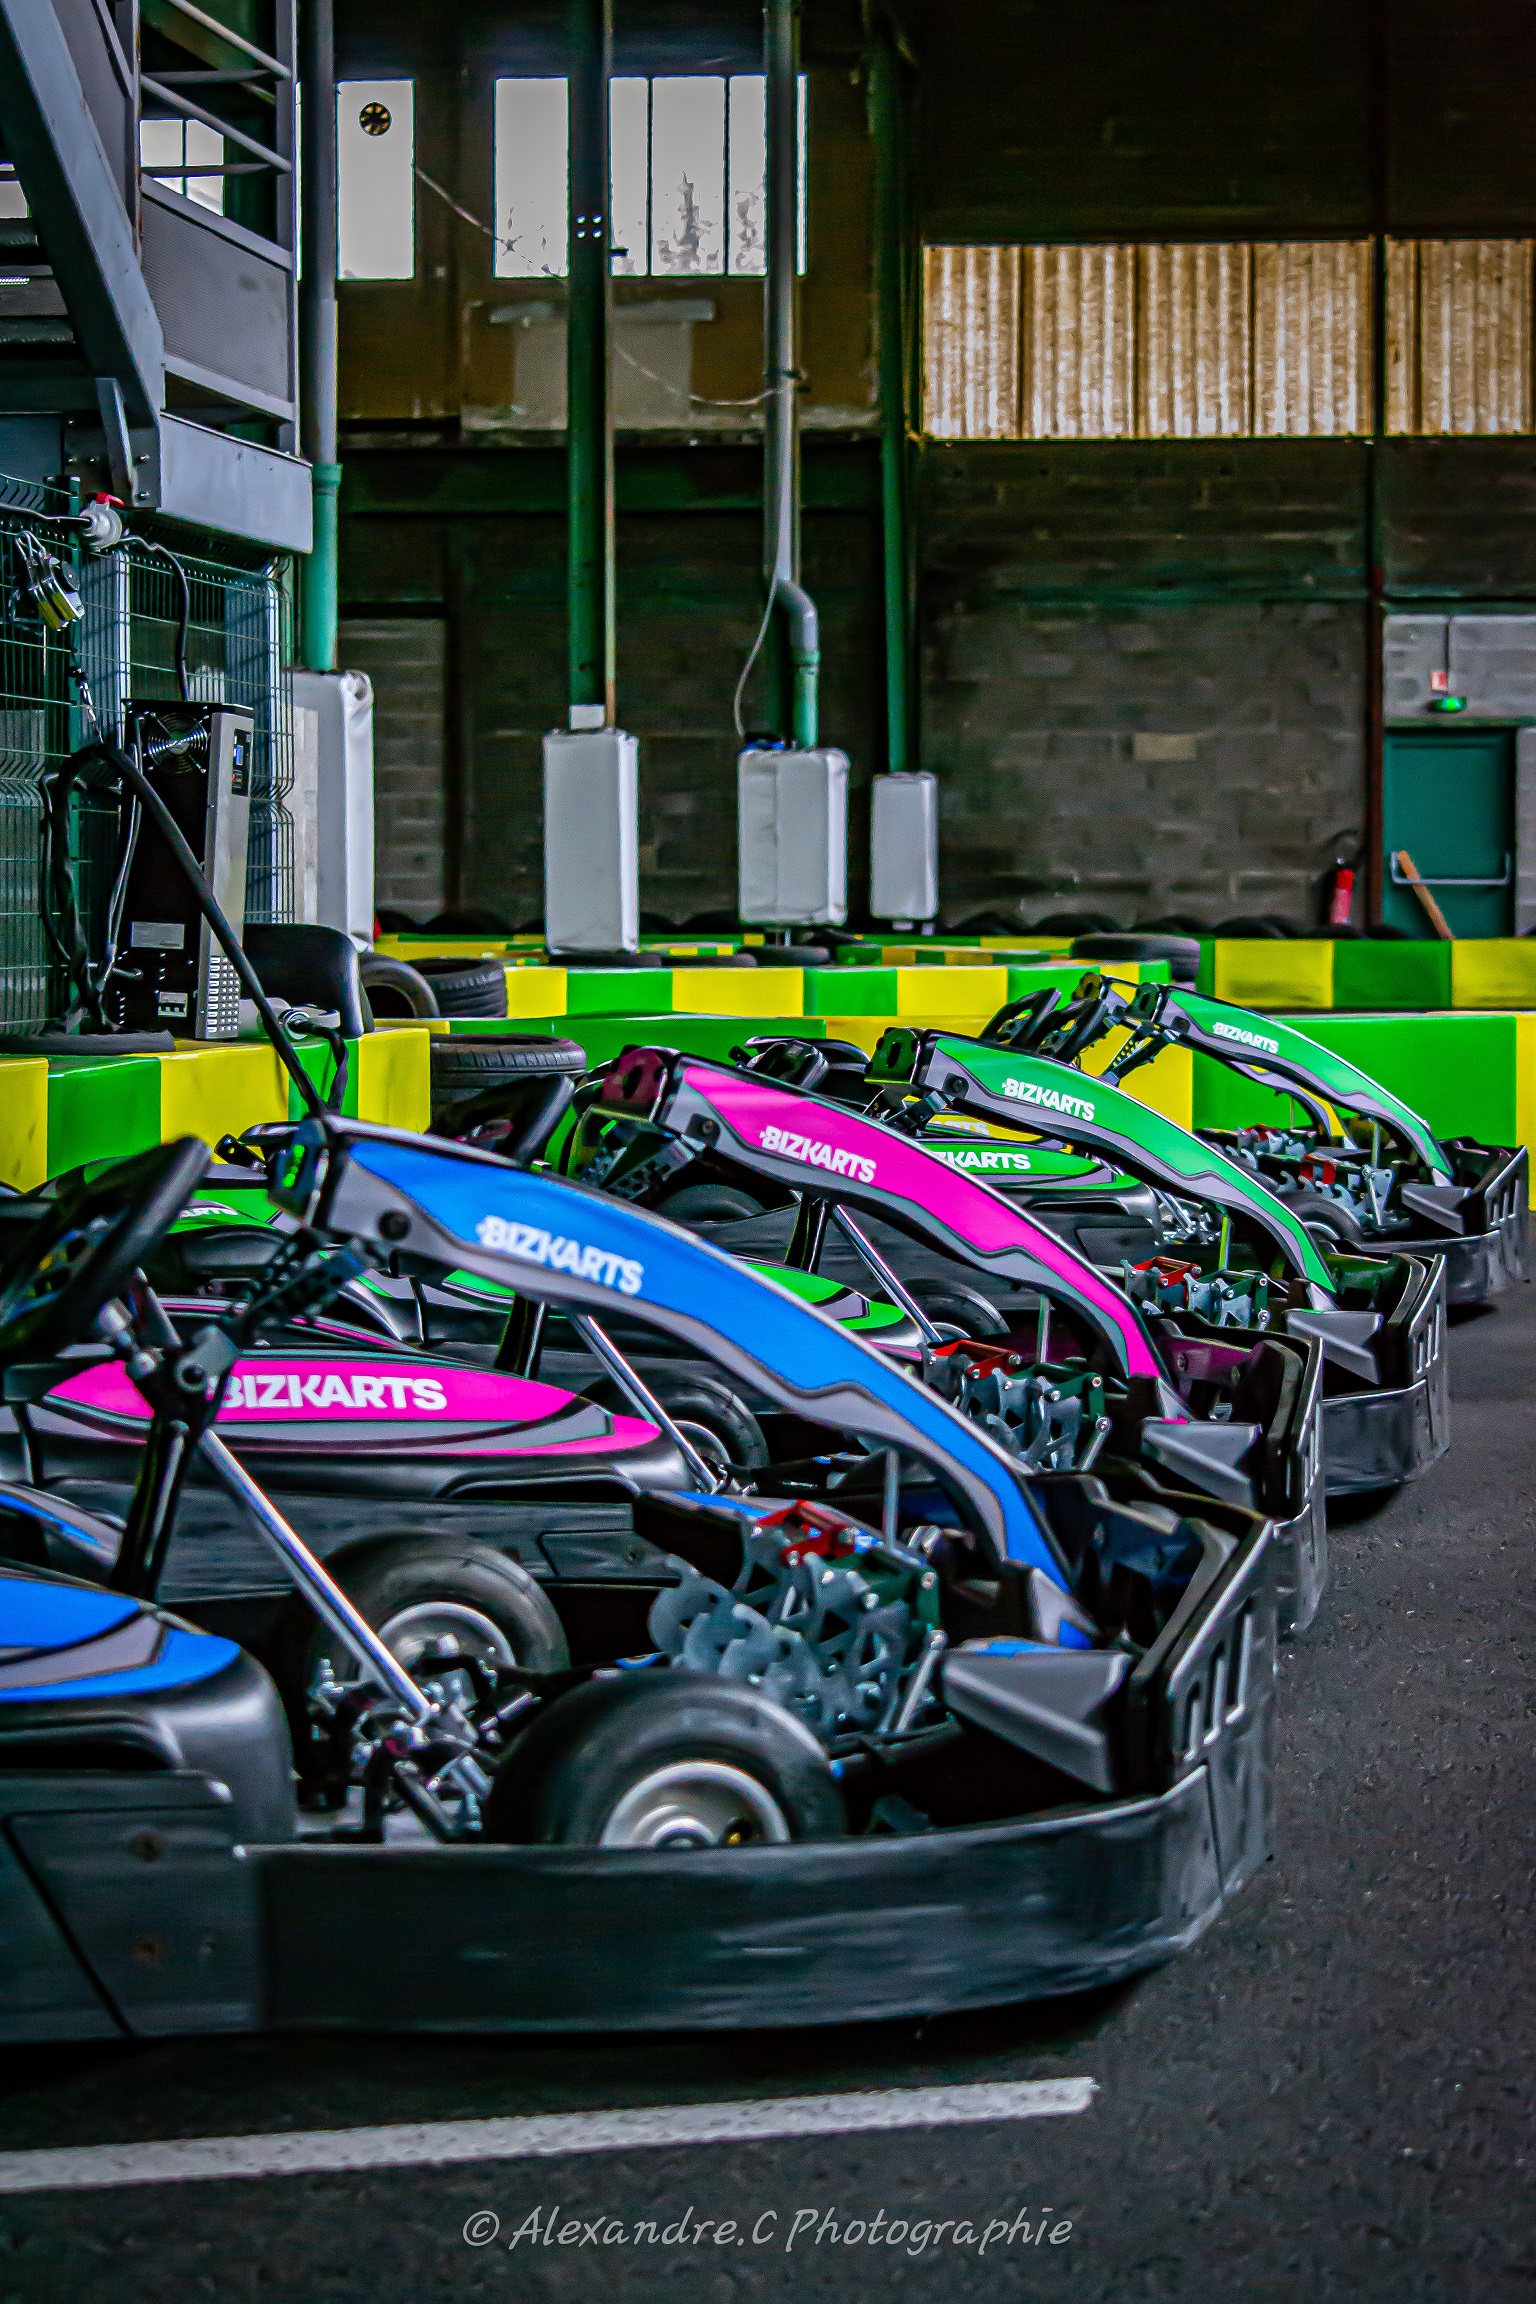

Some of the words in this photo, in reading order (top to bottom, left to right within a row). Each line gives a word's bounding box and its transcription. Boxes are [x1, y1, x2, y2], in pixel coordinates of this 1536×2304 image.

[1213, 1021, 1280, 1055] BIZKARTS
[1002, 1077, 1095, 1121] BIZKARTS
[760, 1125, 877, 1183] BIZKARTS
[934, 1151, 1031, 1170] KARTS
[476, 1215, 644, 1295] BIZKARTS
[221, 1374, 448, 1411] BIZKARTS
